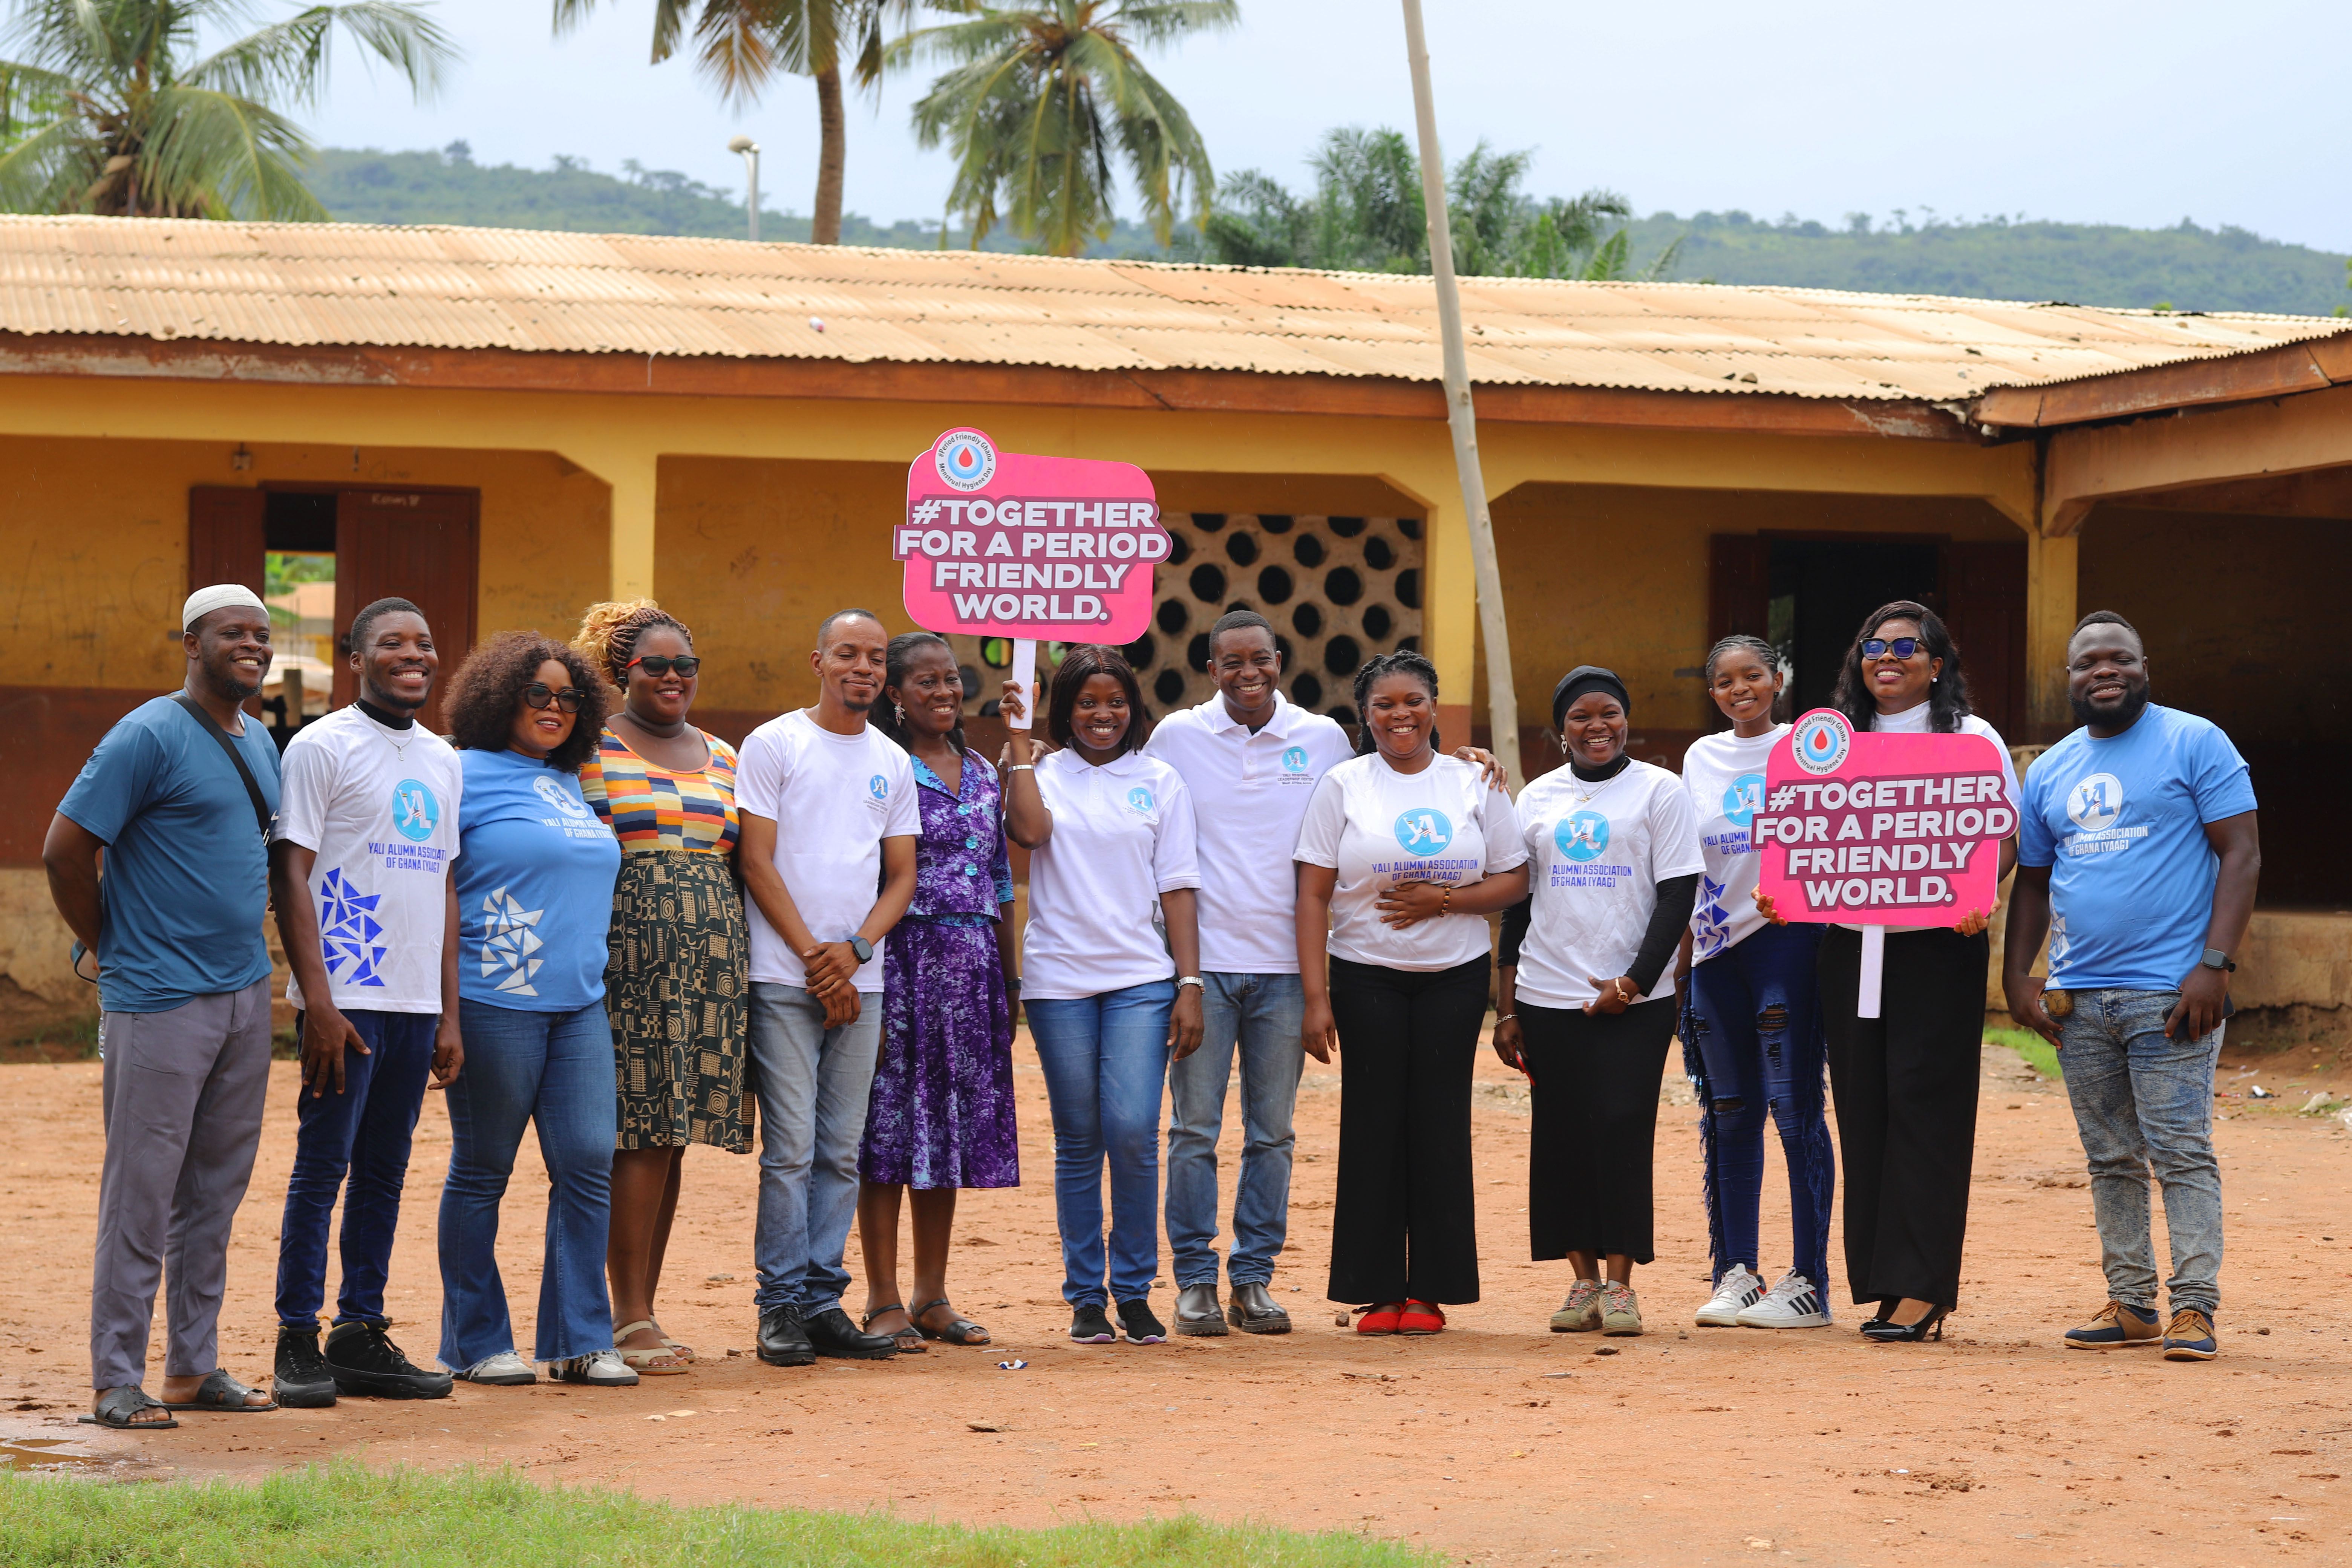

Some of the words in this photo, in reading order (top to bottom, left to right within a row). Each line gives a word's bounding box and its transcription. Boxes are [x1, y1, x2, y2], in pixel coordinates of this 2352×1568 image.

[938, 436, 955, 457] #Period
[955, 433, 981, 444] Friendly
[980, 442, 992, 461] Ghana
[939, 463, 961, 487] Menstrual
[962, 476, 985, 490] Hygiene
[983, 467, 993, 478] Day
[912, 499, 1156, 527] #TOGETHER
[899, 530, 977, 556] FOR
[985, 531, 1014, 556] A
[1023, 532, 1167, 558] PERIOD
[936, 562, 1129, 589] FRIENDLY
[953, 593, 1108, 620] WORLD.
[1795, 720, 1812, 741] #Period
[1812, 715, 1837, 726] Friendly
[1835, 722, 1846, 742] Ghana
[1795, 747, 1816, 771] Menstrual
[1816, 759, 1839, 773] Hygiene
[1837, 747, 1847, 759] Day
[1768, 776, 2003, 812] #TOGETHER
[541, 818, 561, 827] YALI
[564, 828, 573, 838] OF
[1755, 816, 1830, 844] FOR
[1836, 815, 1864, 841] A
[1872, 807, 2014, 839] PERIOD
[1703, 835, 1718, 847] YALI
[1720, 831, 1749, 844] ALUMNI
[2095, 826, 2148, 841] ASSOCIATION
[368, 842, 384, 854] YALI
[388, 844, 416, 857] ALUMNI
[1721, 845, 1730, 854] OF
[1788, 841, 1975, 875] FRIENDLY
[2075, 842, 2100, 855] GHANA
[386, 857, 396, 868] OF
[398, 858, 421, 871] GHANA
[1372, 863, 1390, 873] YALI
[1393, 860, 1427, 871] ALUMNI
[1428, 859, 1478, 870] ASSOCIATION
[1553, 865, 1582, 875] ALUMNI
[1583, 865, 1632, 876] ASSOCIATION
[1392, 873, 1401, 881] OF
[1551, 877, 1560, 887] OF
[1561, 876, 1586, 887] GHANA
[1804, 876, 1953, 907] WORLD.
